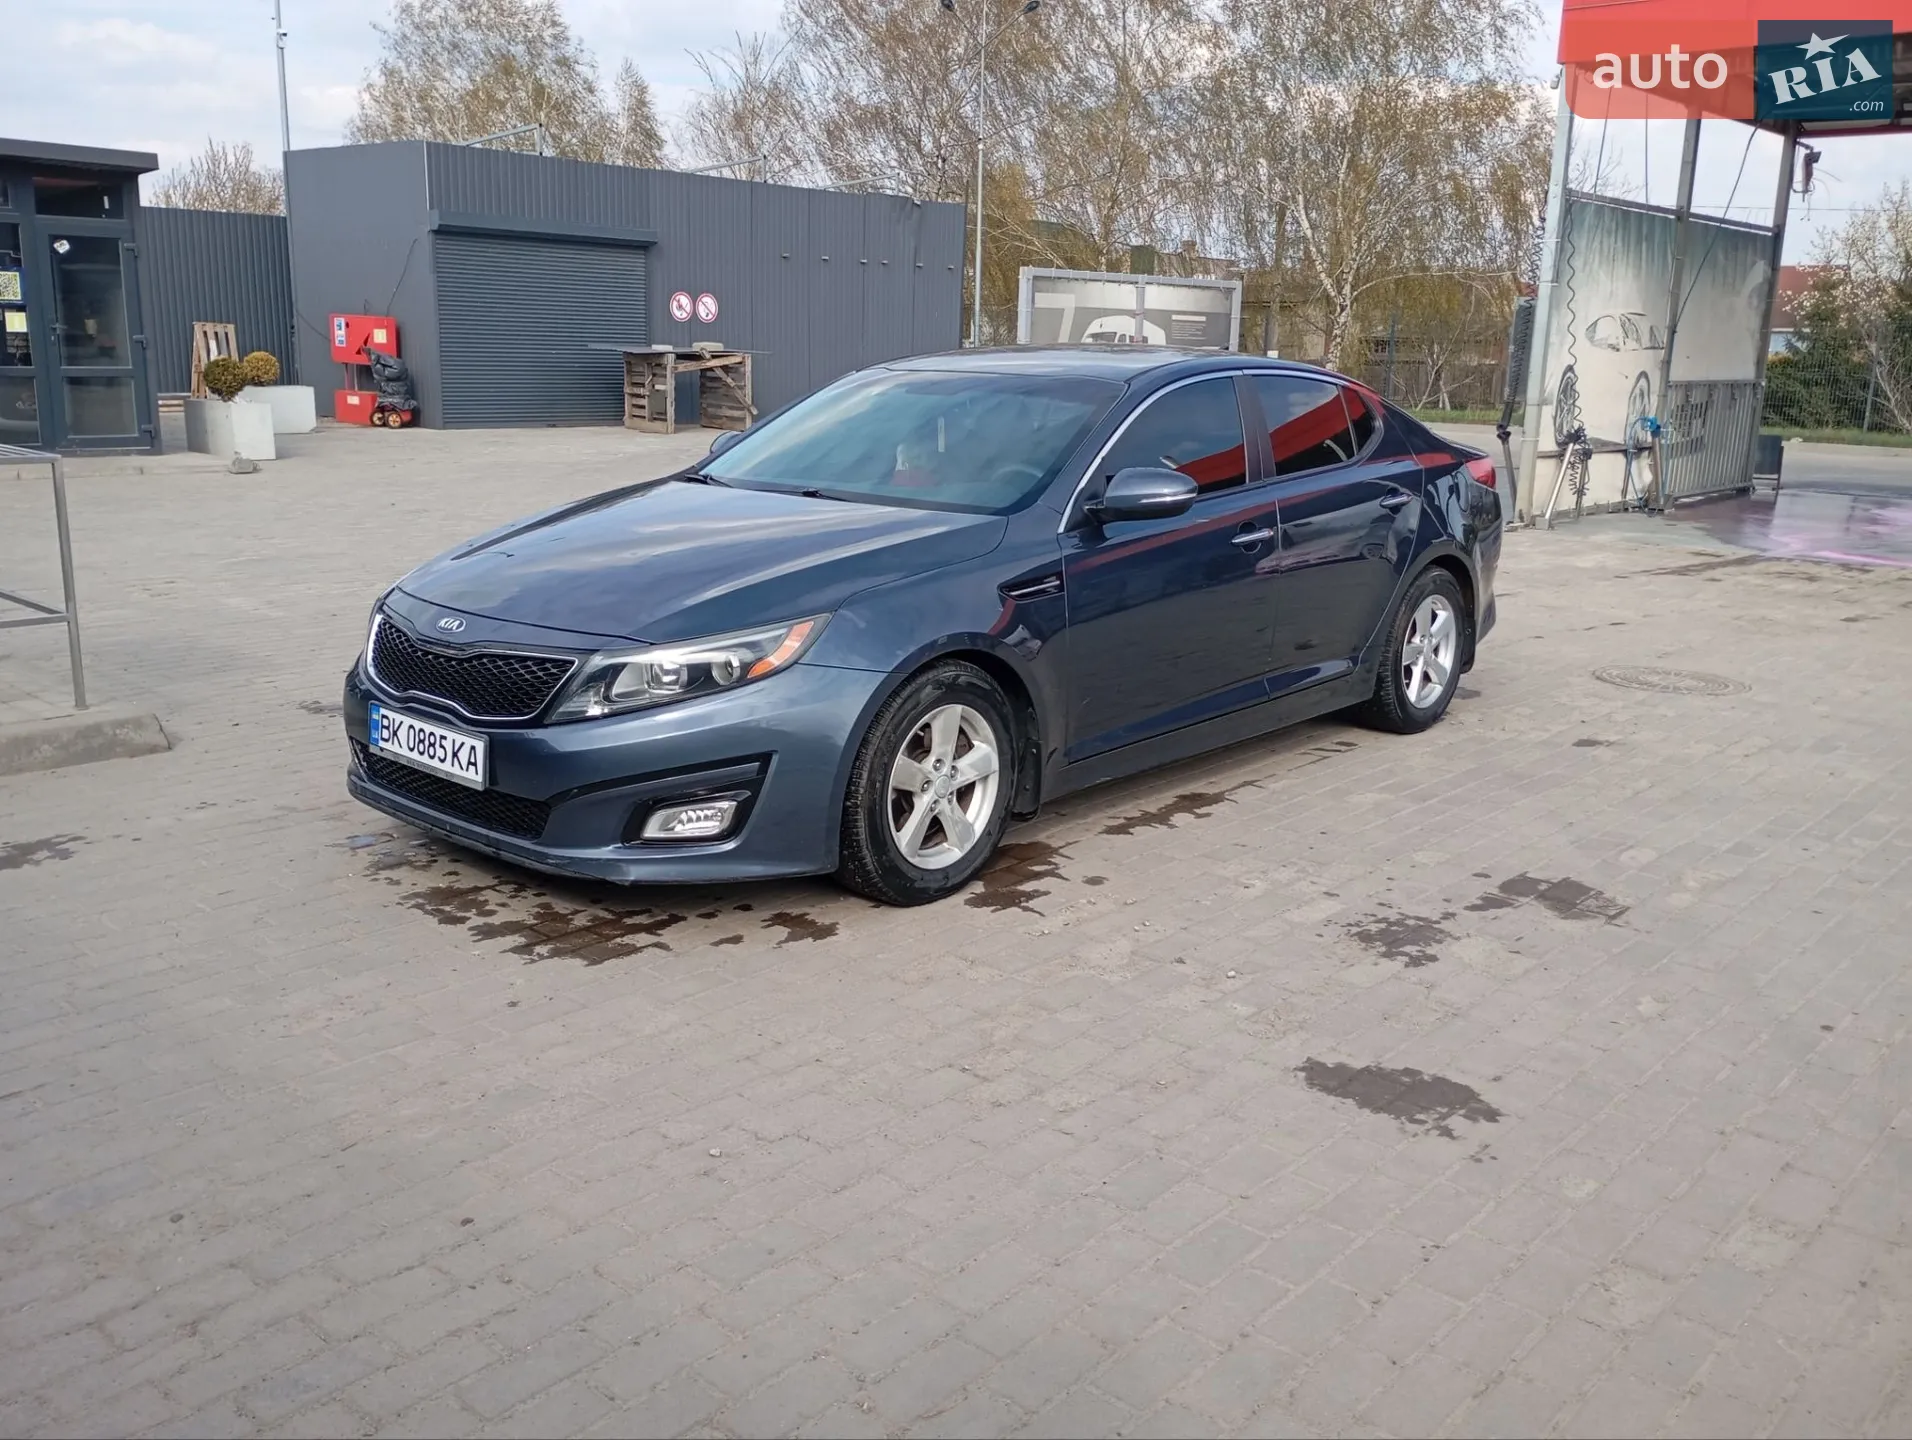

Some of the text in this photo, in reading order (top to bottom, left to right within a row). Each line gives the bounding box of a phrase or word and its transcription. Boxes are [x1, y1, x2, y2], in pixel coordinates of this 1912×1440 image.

[438, 617, 460, 630] KIA
[380, 713, 404, 749] BK
[406, 724, 448, 763] 0885
[451, 738, 479, 776] KA
